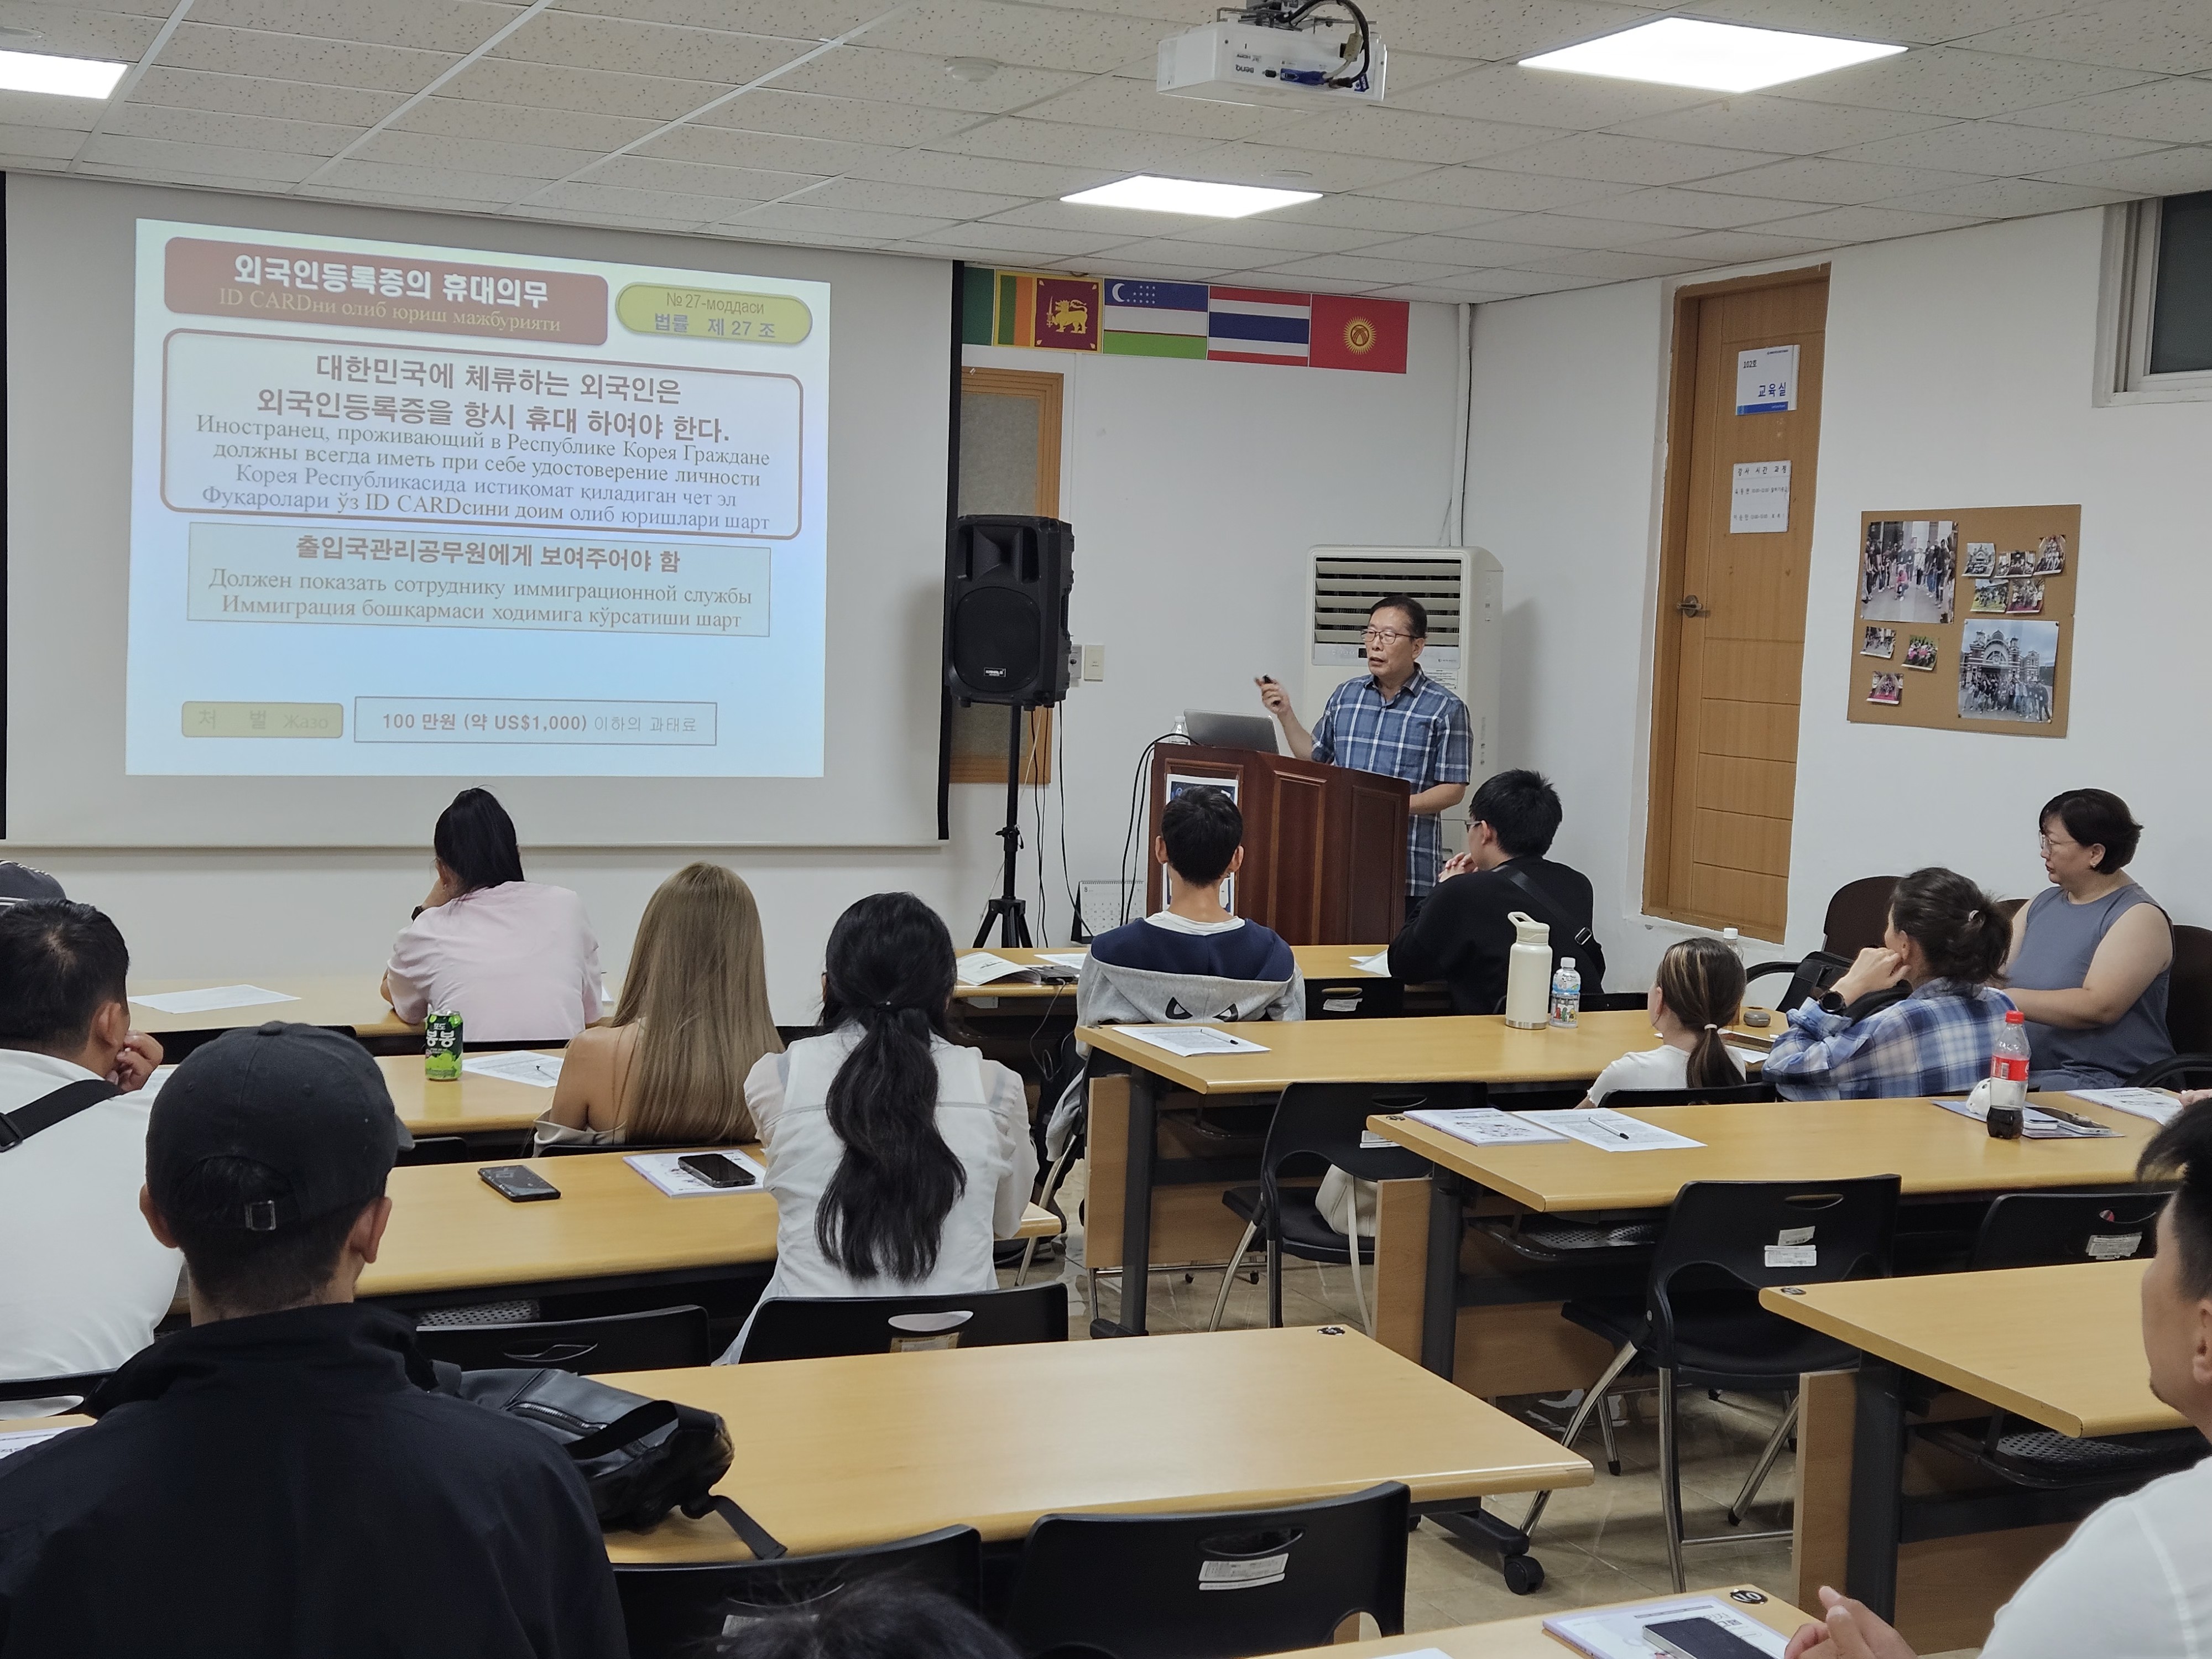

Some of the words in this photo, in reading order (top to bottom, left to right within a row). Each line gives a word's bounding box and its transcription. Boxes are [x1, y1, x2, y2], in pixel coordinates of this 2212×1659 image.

[234, 254, 431, 299] 외국인등록증의
[441, 273, 549, 309] 휴대의무
[218, 288, 243, 305] ID
[249, 291, 336, 314] CARDни
[342, 300, 387, 319] олиб
[392, 306, 446, 325] юриш
[453, 311, 561, 333] мажбурияти
[655, 312, 689, 333] 법률
[707, 318, 725, 336] 제
[731, 320, 752, 336] 27
[758, 322, 776, 338] 조
[316, 354, 454, 389] 대한민국에
[466, 363, 570, 397] 체류하는
[580, 373, 681, 405] 외국인은
[1758, 382, 1787, 398] 교육실
[257, 389, 453, 426] 외국인등록증을
[464, 401, 515, 430] 항시
[525, 405, 577, 434] 휴대
[587, 410, 664, 439] 하여야
[674, 415, 730, 444] 한다.
[196, 414, 331, 442] Иностранец,
[337, 427, 484, 450] проживающий
[491, 438, 502, 449] в
[507, 434, 616, 457] Республике
[623, 441, 677, 463] Корея
[684, 445, 770, 466] Граждане
[213, 443, 298, 461] должны
[305, 448, 371, 466] всегда
[377, 454, 435, 468] иметь
[442, 457, 478, 474] при
[484, 457, 526, 473] себе
[531, 461, 669, 482] удостоверение
[675, 471, 761, 487] личности
[236, 464, 298, 487] Корея
[305, 467, 467, 494] Республикасида
[683, 493, 713, 506] чет
[718, 495, 736, 507] эл
[337, 492, 359, 514] ўз
[365, 493, 390, 511] ID
[397, 495, 509, 517] CARDсини
[515, 505, 563, 520] доим
[570, 506, 615, 523] олиб
[621, 512, 719, 529] юришлари
[724, 517, 771, 534] шарт
[296, 535, 533, 567] 출입국관리공무원에게
[540, 545, 652, 572] 보여주어야
[660, 550, 681, 573] 함
[208, 568, 292, 589] Должен
[299, 576, 387, 592] показать
[394, 579, 505, 598] сотруднику
[513, 582, 677, 602] иммиграционной
[684, 587, 752, 607] службы
[222, 594, 356, 618] Иммиграция
[492, 607, 582, 623] ходимига
[588, 607, 690, 629] кўрсатиши
[696, 615, 742, 632] шарт
[199, 709, 216, 730] 처
[249, 710, 267, 730] 벌
[383, 713, 415, 729] 100
[421, 713, 456, 731] 만원
[463, 713, 488, 731] (약
[494, 713, 588, 733] US$1,000)
[594, 716, 643, 733] 이하의
[649, 717, 697, 733] 과태료
[426, 1029, 456, 1048] 봉봉
